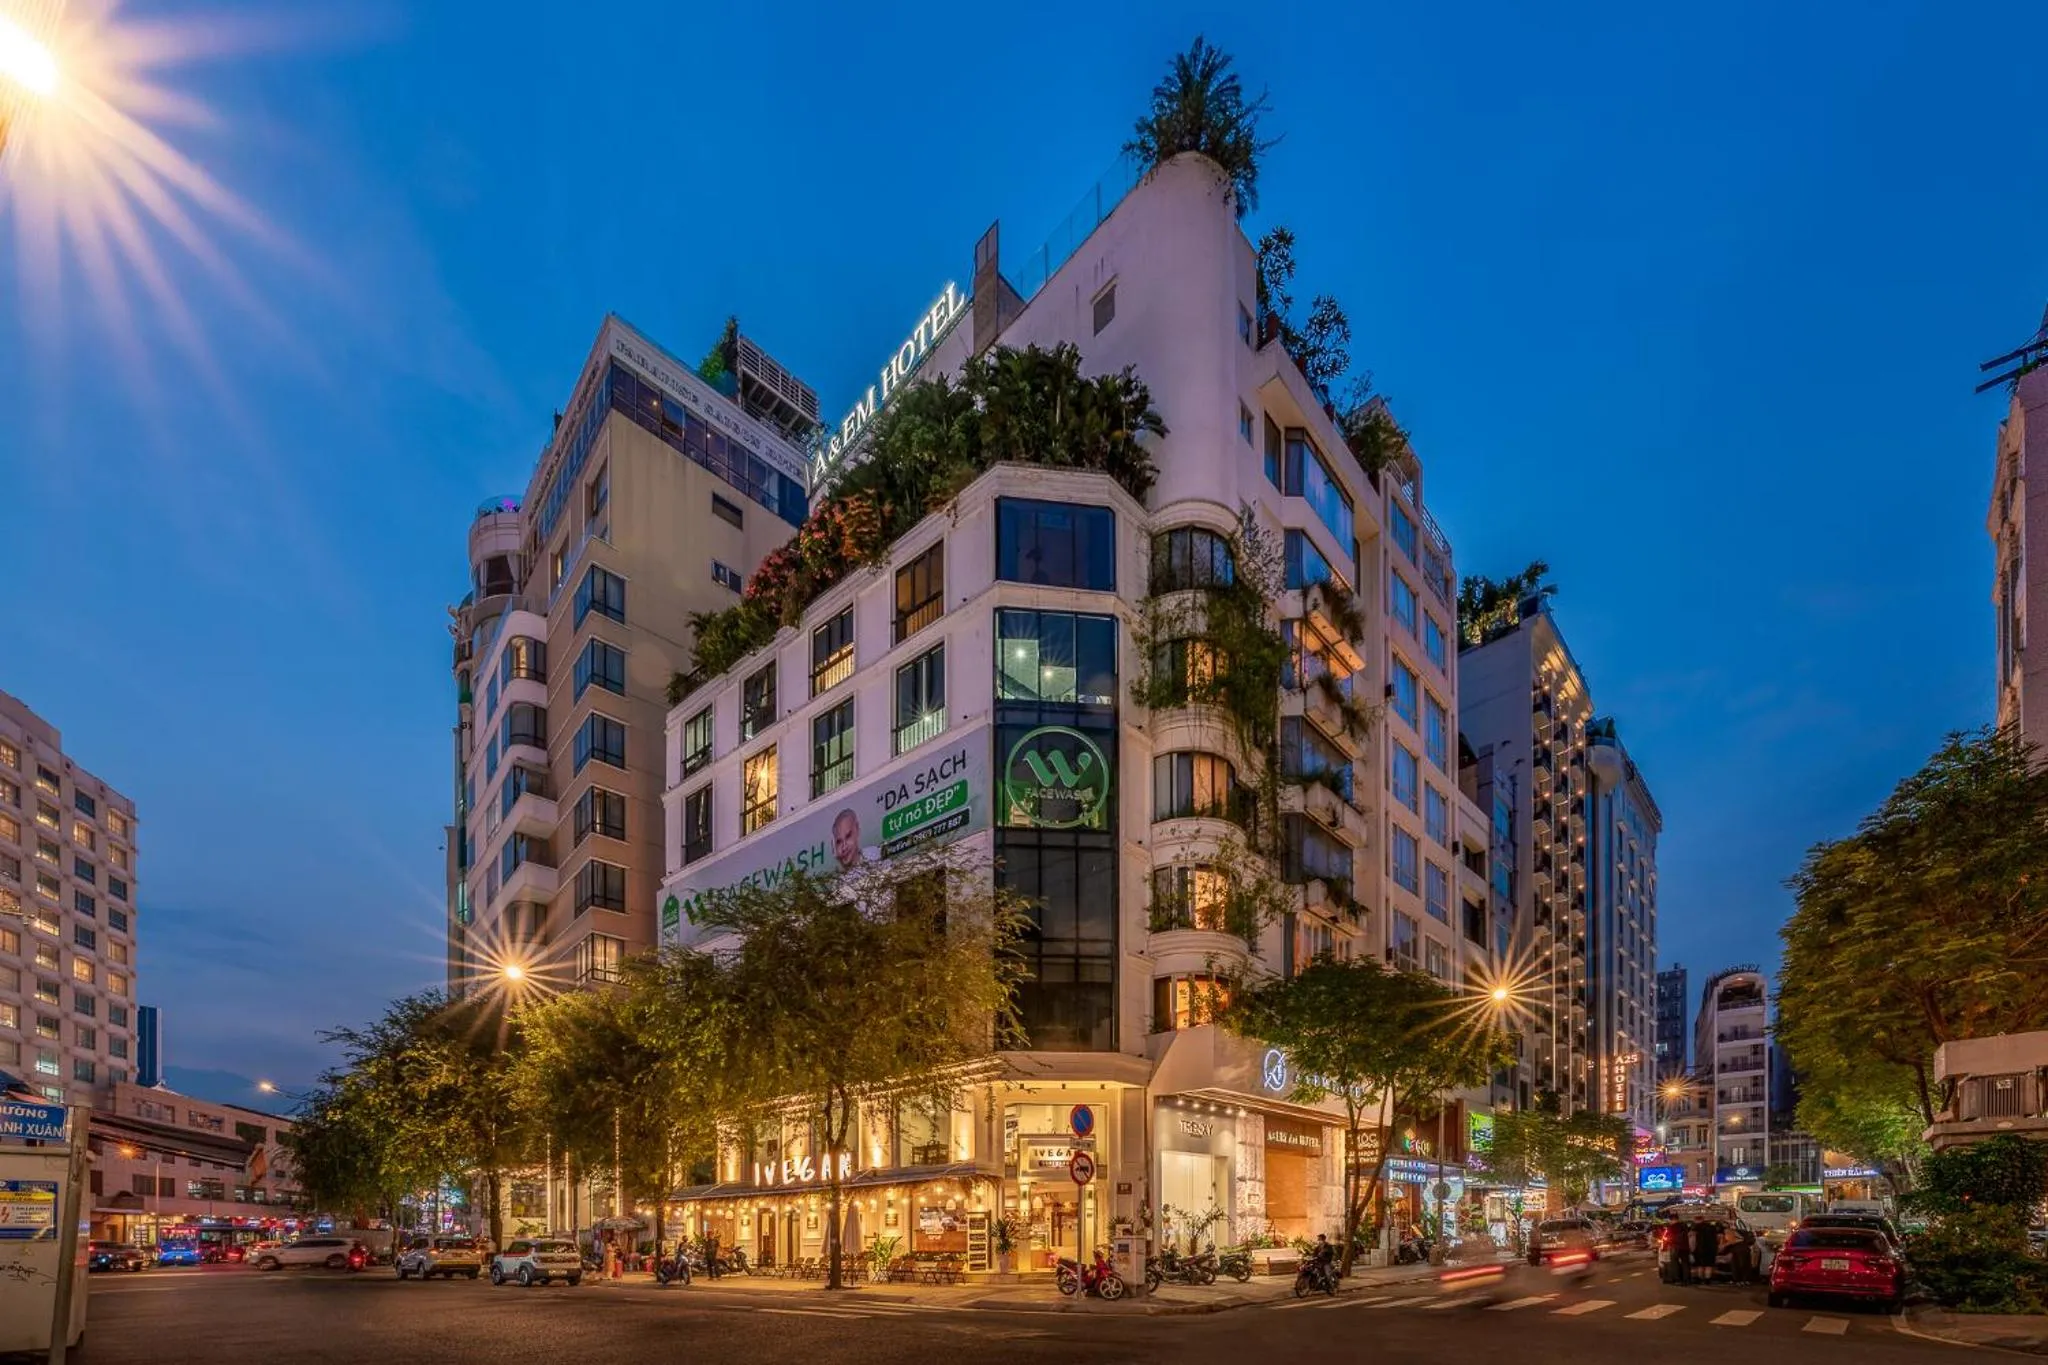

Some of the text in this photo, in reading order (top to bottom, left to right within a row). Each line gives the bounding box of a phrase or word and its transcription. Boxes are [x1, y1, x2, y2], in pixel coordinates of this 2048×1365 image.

[881, 282, 965, 402] HOTEL
[914, 749, 966, 794] SẠCH
[1615, 1066, 1625, 1111] HOTEL
[0, 1104, 48, 1119] ƯỜNG
[26, 1122, 63, 1137] XUÂN
[1033, 1148, 1074, 1158] IVEGA
